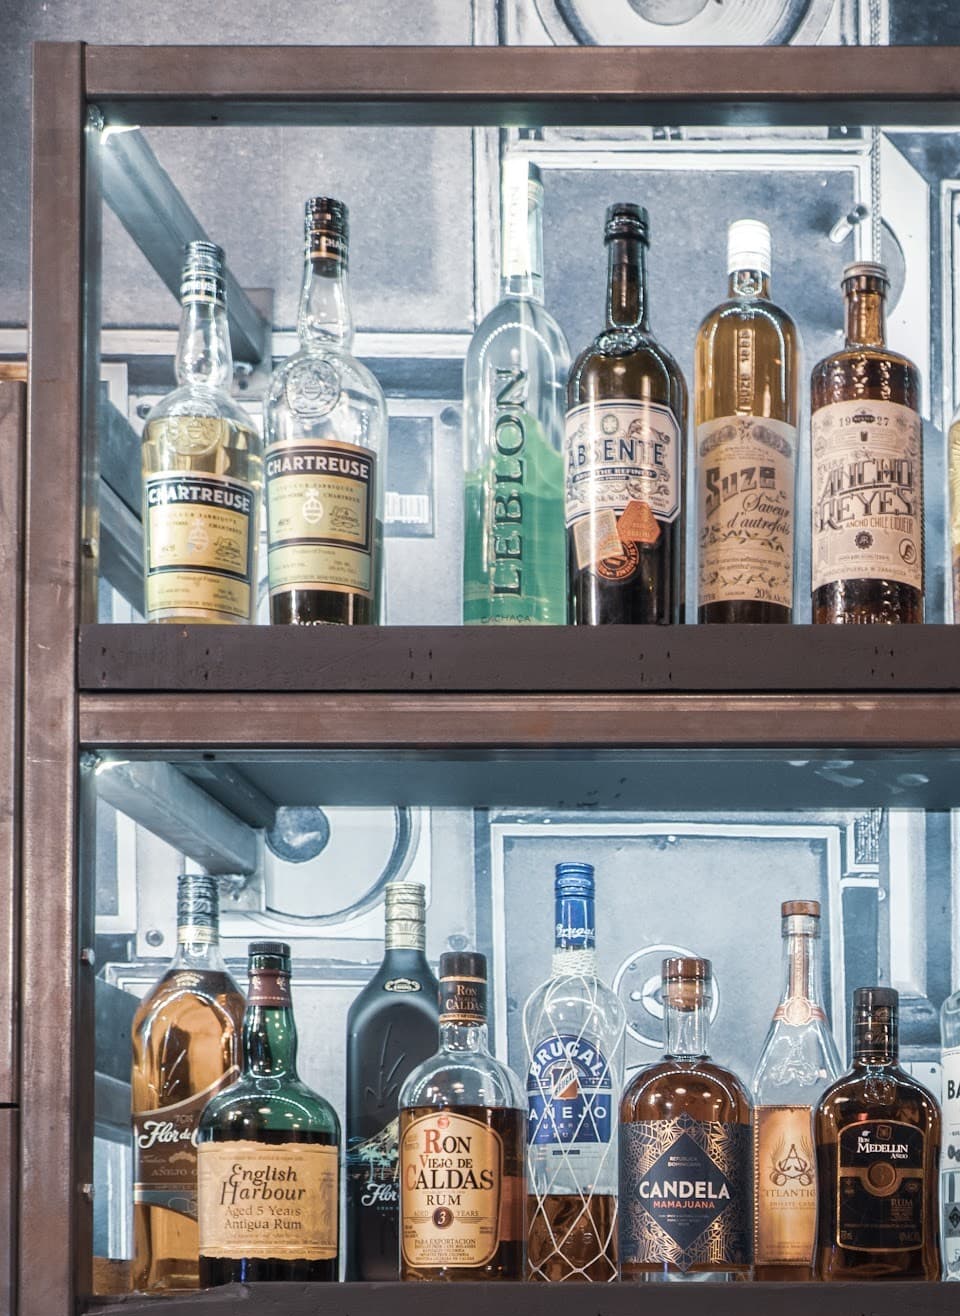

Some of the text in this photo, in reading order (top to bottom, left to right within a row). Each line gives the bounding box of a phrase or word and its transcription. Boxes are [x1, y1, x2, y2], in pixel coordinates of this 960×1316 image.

[568, 438, 664, 470] ABENE
[267, 455, 369, 480] CHARTREUSE
[492, 368, 526, 596] LEBLON
[821, 458, 913, 502] ANCHO
[148, 483, 250, 513] CHARTREUSE
[742, 493, 790, 519] Saveur
[816, 484, 917, 536] REYES
[446, 999, 484, 1011] CALDAS
[530, 1041, 603, 1077] BRUGAL
[529, 1104, 607, 1121] AÑEJO
[138, 1121, 191, 1149] Flor de
[423, 1129, 472, 1154] RON
[857, 1142, 908, 1154] MEDELLIN
[419, 1154, 472, 1168] VIEJO DE
[229, 1163, 297, 1187] English
[405, 1164, 494, 1191] CALDAS
[220, 1181, 306, 1205] Harbour
[361, 1183, 397, 1207] Flor
[426, 1194, 462, 1206] RUM
[639, 1180, 730, 1200] CANDELA
[224, 1205, 301, 1218] Aged 5 Years
[653, 1200, 715, 1209] MAMAJUANA
[224, 1220, 302, 1231] Antigua Rum
[437, 1211, 447, 1225] 3
